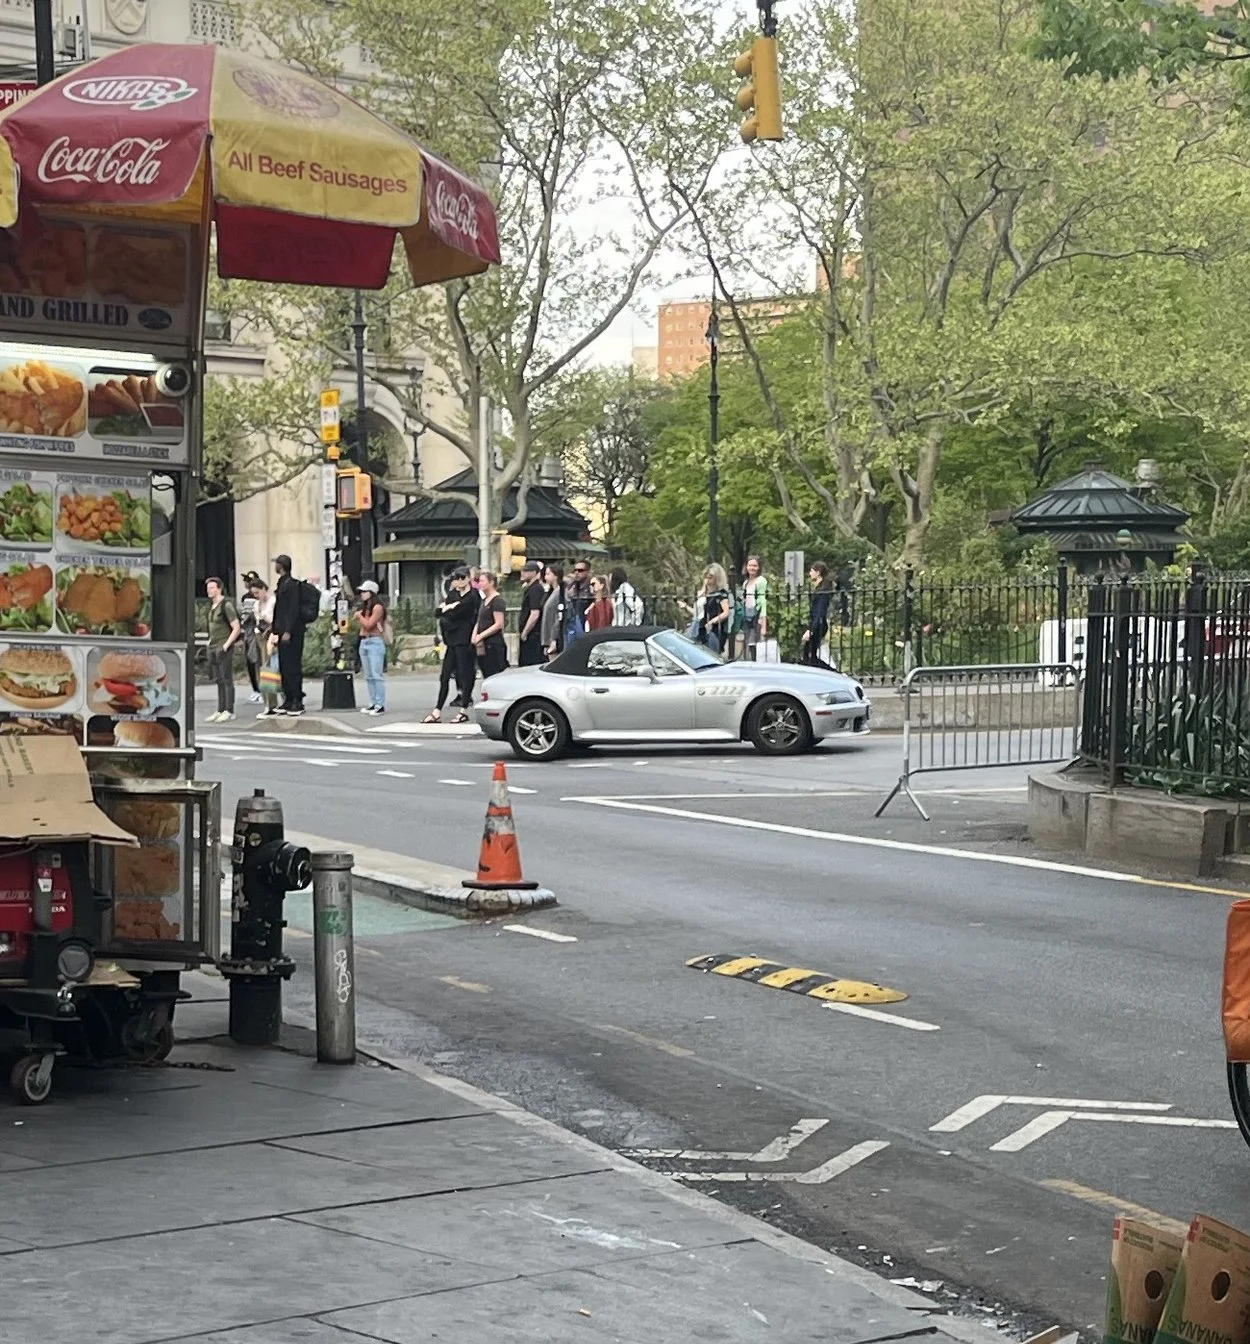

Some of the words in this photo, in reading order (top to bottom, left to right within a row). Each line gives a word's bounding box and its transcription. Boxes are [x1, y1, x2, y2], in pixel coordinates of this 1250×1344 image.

[81, 80, 171, 100] NIKAS
[228, 151, 252, 172] All
[258, 155, 304, 180] Beef
[310, 162, 408, 195] Sausages
[42, 299, 129, 326] GRILLED
